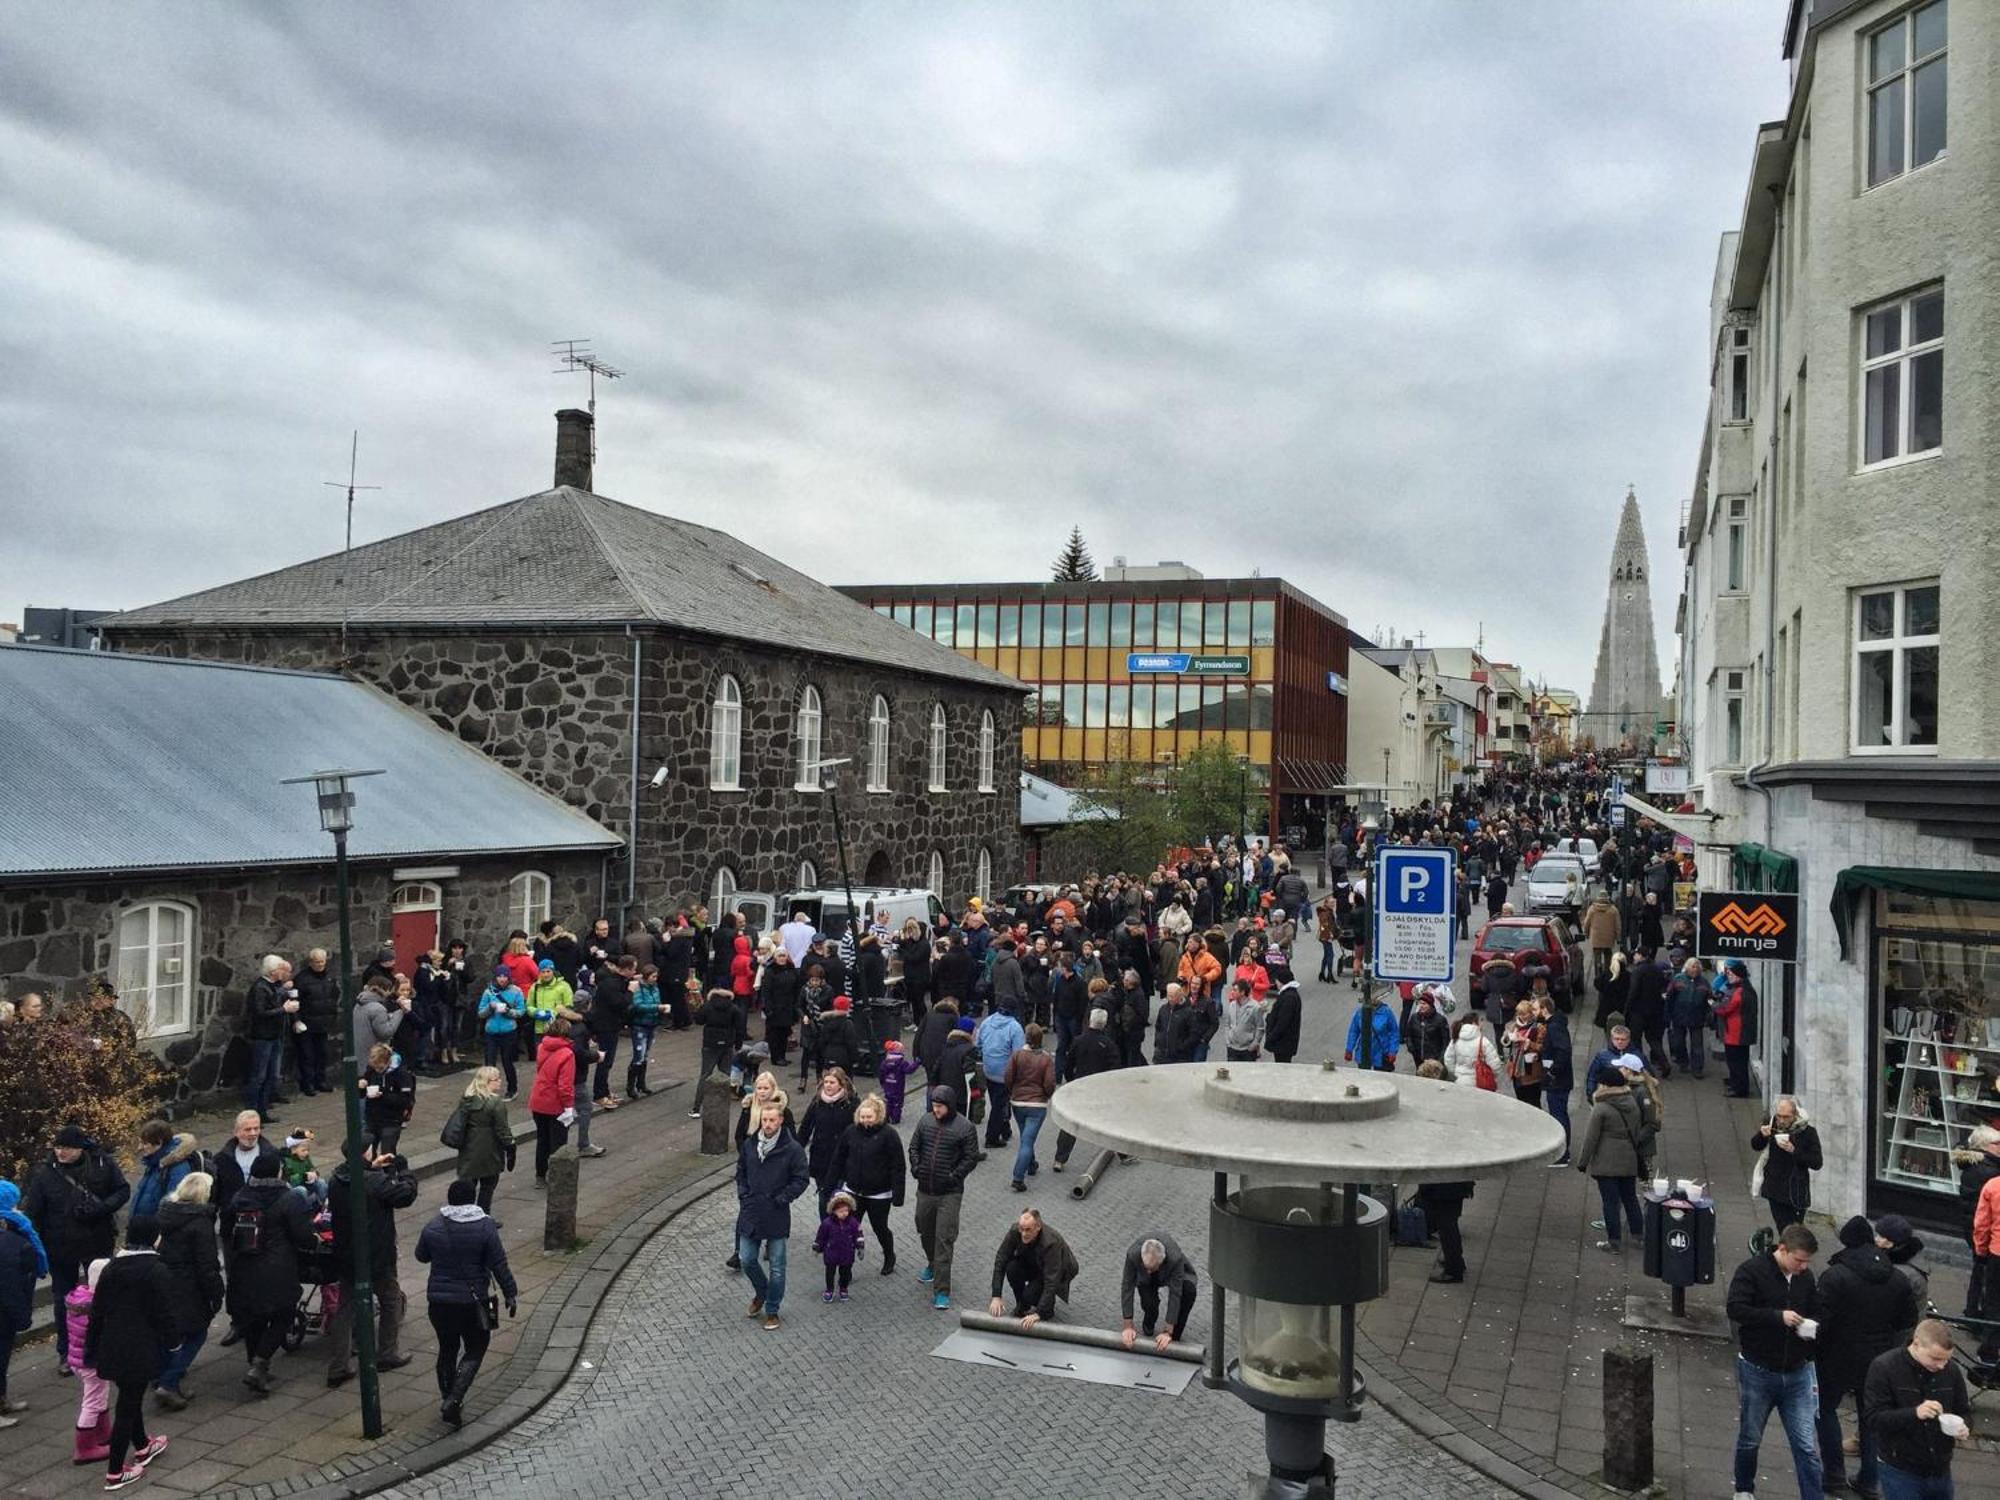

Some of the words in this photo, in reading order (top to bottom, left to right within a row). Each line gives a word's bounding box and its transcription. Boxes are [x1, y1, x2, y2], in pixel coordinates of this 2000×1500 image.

[1401, 866, 1430, 903] P
[1417, 891, 1426, 903] 2
[1718, 936, 1777, 951] minja
